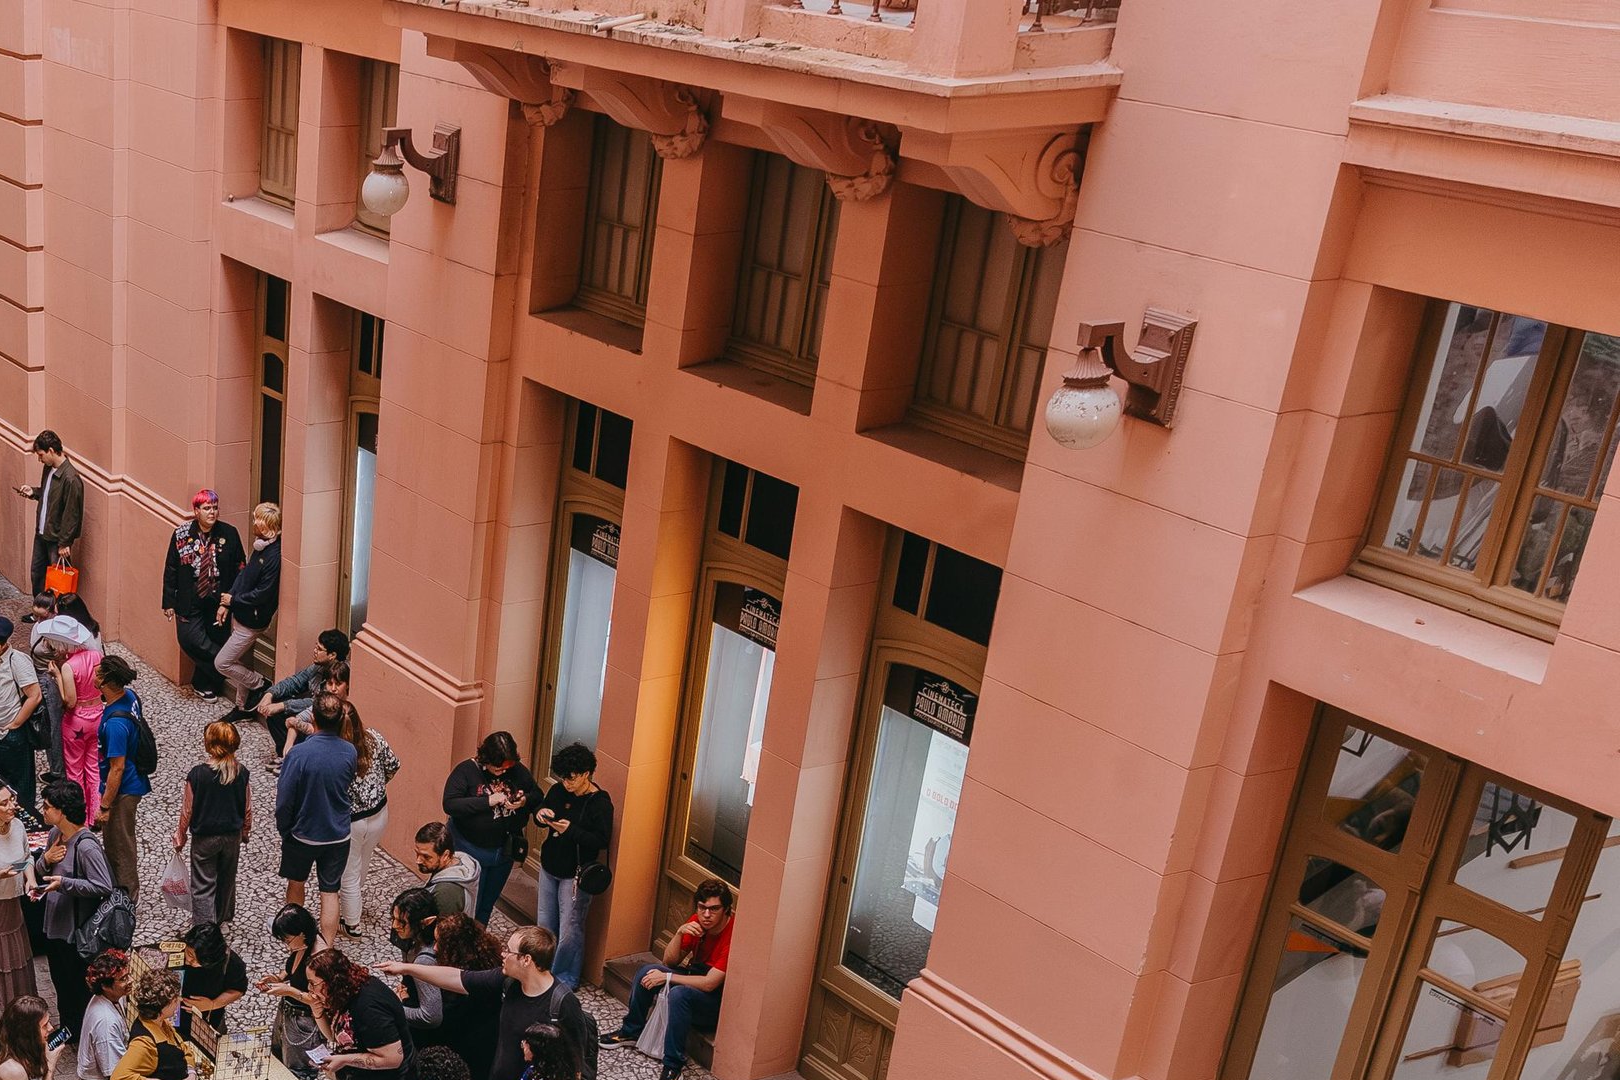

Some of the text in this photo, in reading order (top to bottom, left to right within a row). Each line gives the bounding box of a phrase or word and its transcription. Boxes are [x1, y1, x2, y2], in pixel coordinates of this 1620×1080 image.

[915, 695, 966, 731] PAULO AMORIM
[922, 688, 963, 714] CINEMATECA
